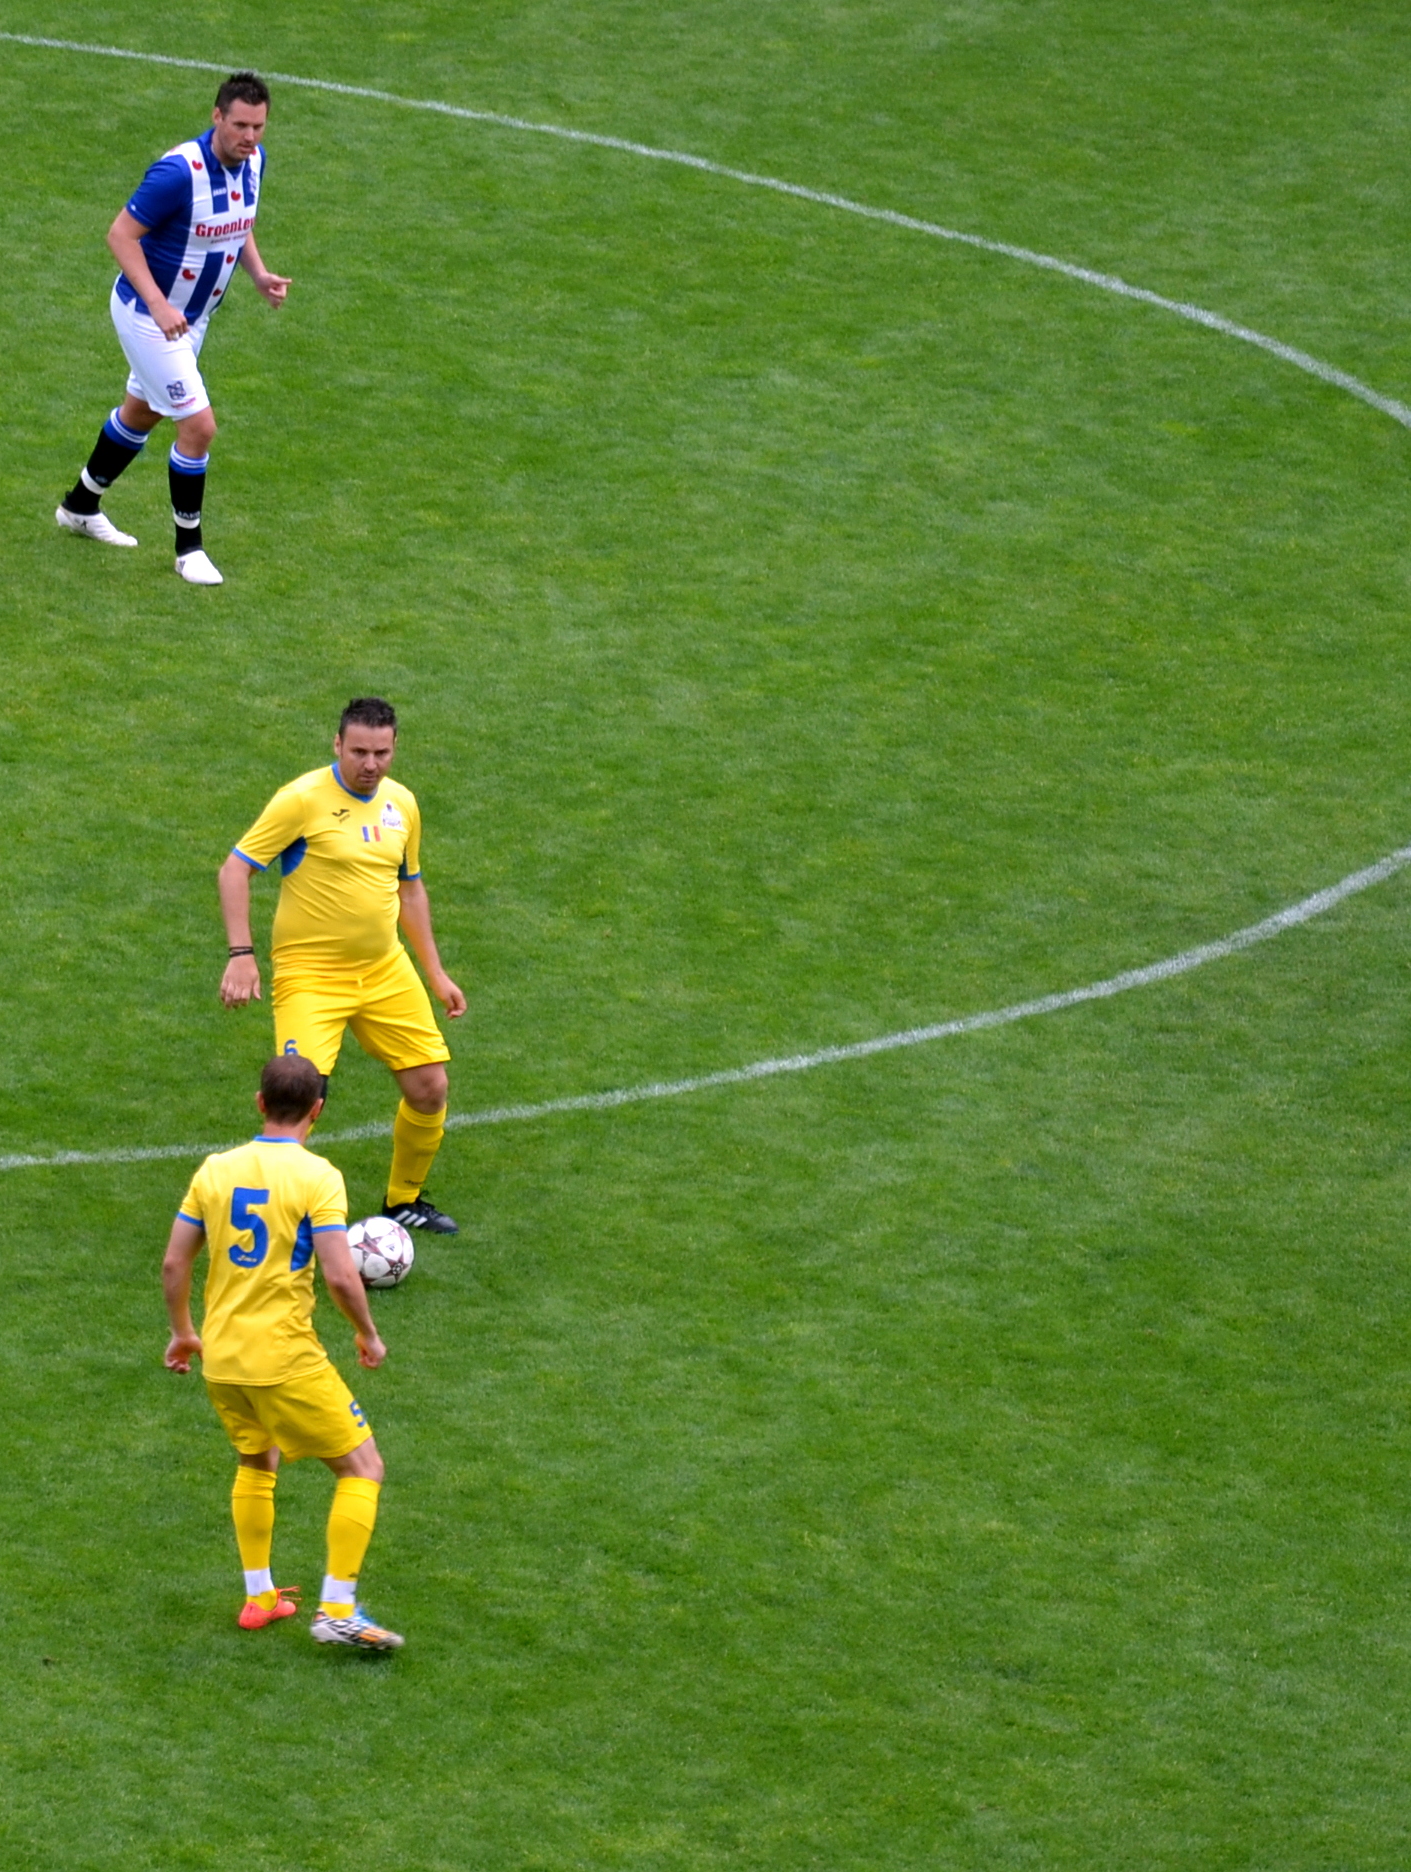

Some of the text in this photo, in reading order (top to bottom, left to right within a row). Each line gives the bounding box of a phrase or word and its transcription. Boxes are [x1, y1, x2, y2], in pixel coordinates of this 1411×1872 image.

[284, 1039, 298, 1056] 6
[229, 1187, 270, 1269] 5
[349, 1399, 367, 1428] 5
